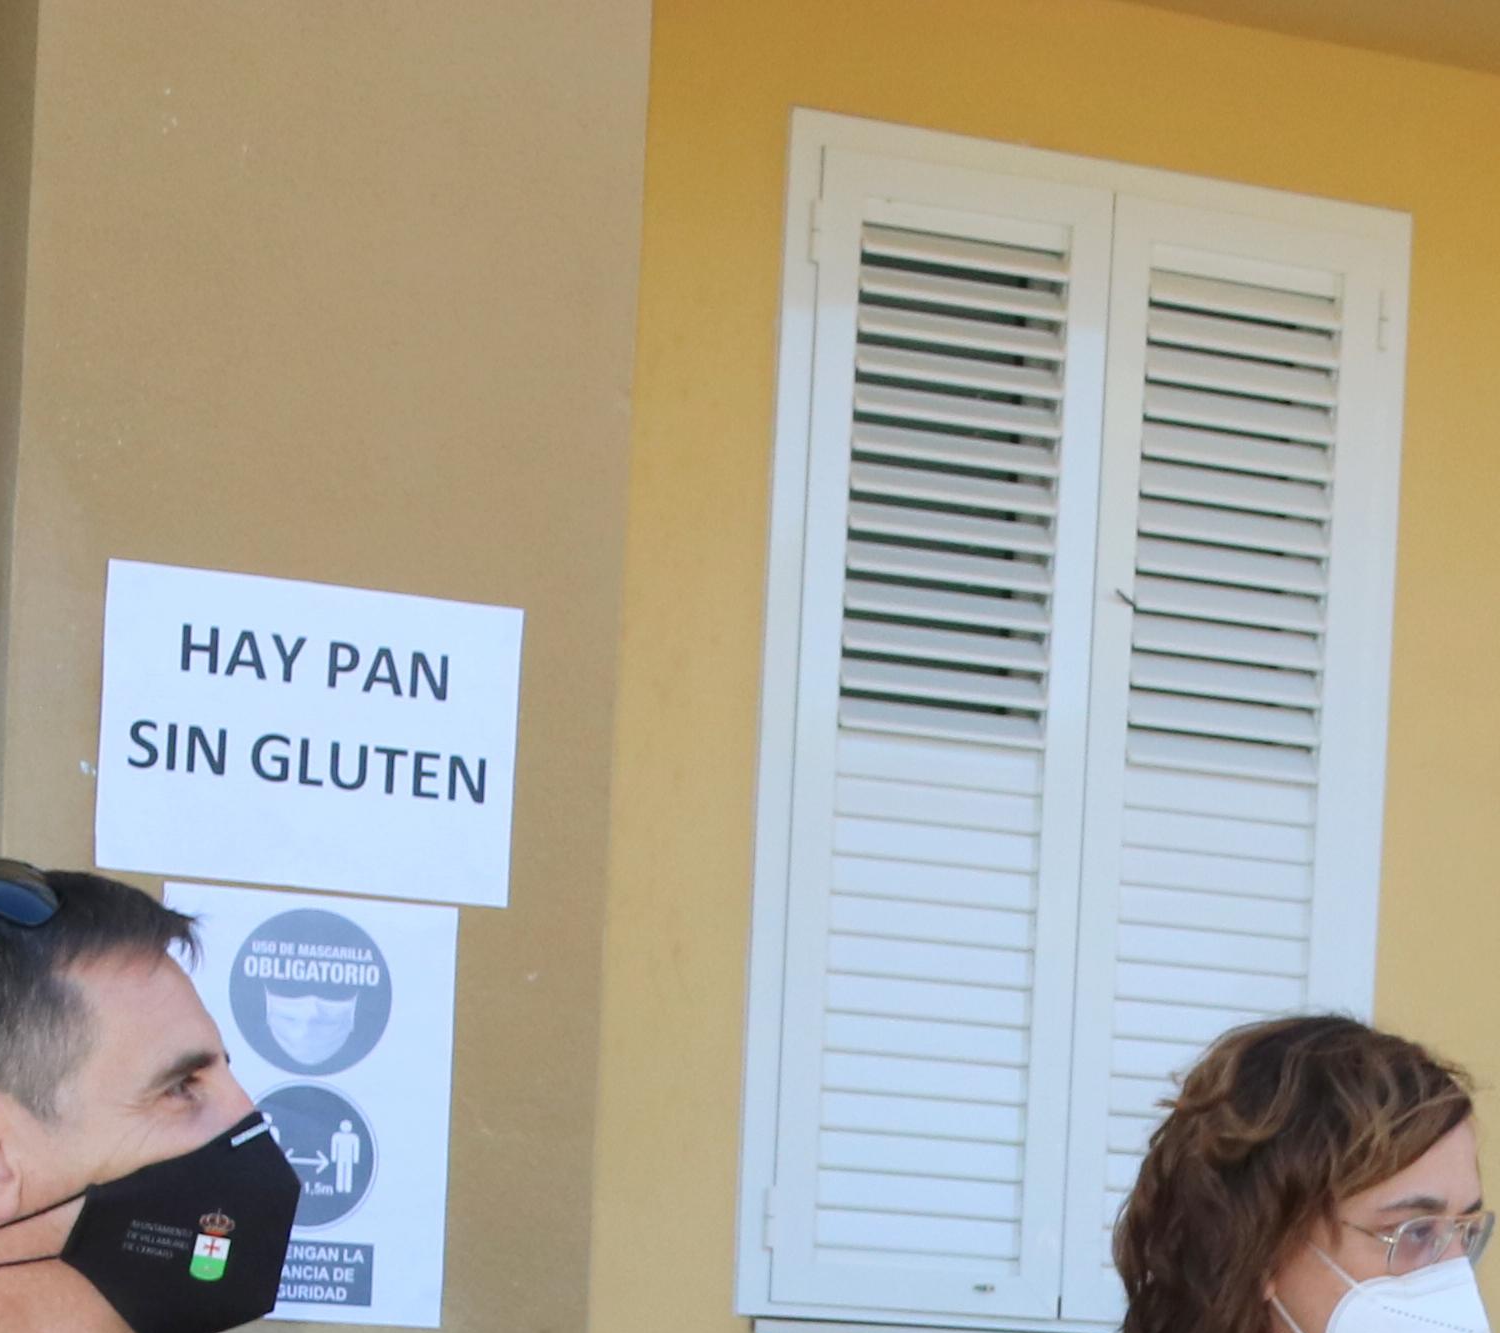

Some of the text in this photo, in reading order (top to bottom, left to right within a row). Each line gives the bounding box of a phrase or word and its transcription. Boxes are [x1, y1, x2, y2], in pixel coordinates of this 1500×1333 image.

[180, 623, 450, 701] HAY PAN
[127, 719, 488, 803] SIN GLUTEN
[252, 940, 374, 962] USO DE MASCARILLA
[244, 956, 381, 987] OBLIGATORIO
[286, 1244, 364, 1264] ENGAN LA
[281, 1265, 355, 1283] ANCIA DE
[277, 1284, 348, 1302] GURIDAD
